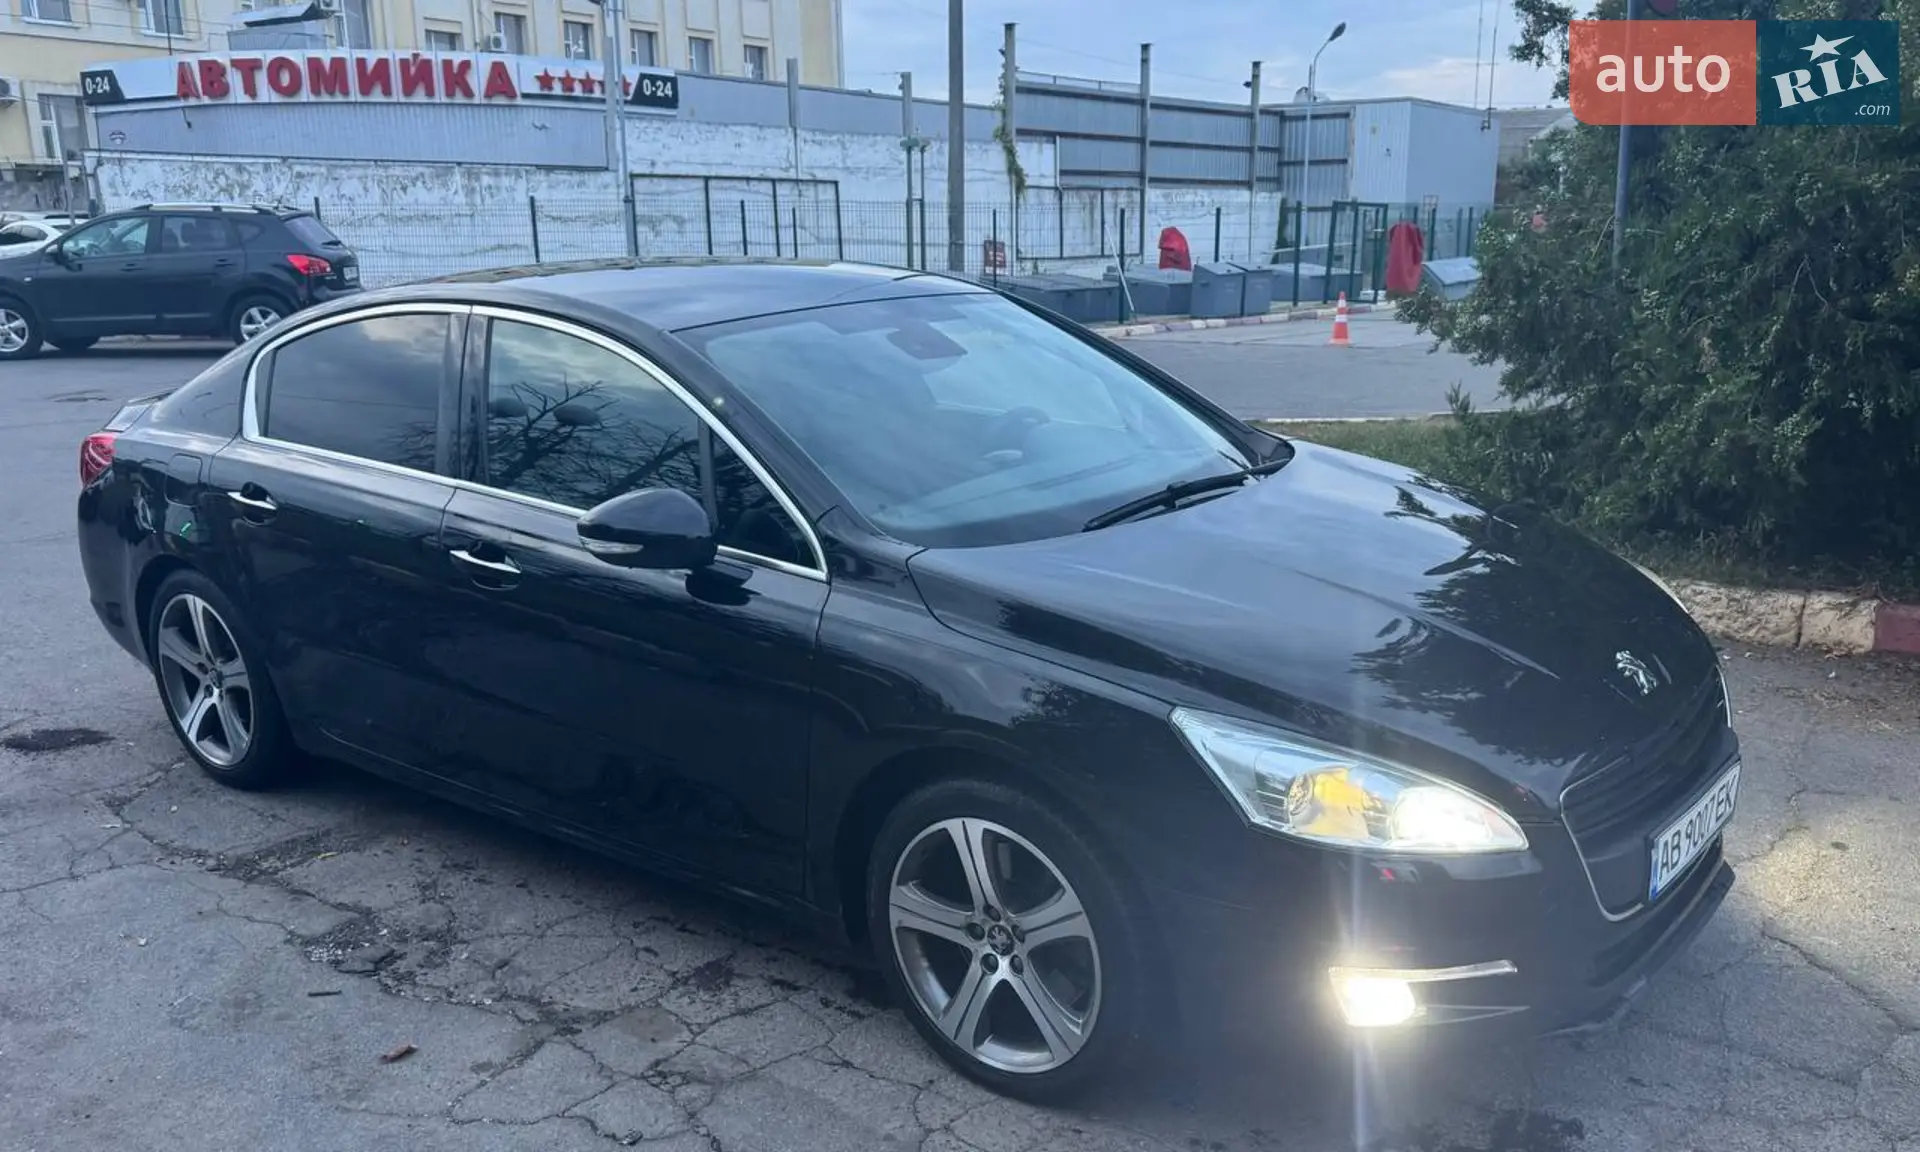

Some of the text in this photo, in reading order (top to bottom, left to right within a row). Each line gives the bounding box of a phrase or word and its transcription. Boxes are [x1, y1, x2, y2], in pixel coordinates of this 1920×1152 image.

[85, 77, 111, 94] 0-24
[176, 53, 518, 99] АВТОМИЙКА
[1659, 831, 1682, 880] AB
[1716, 774, 1737, 822] EK
